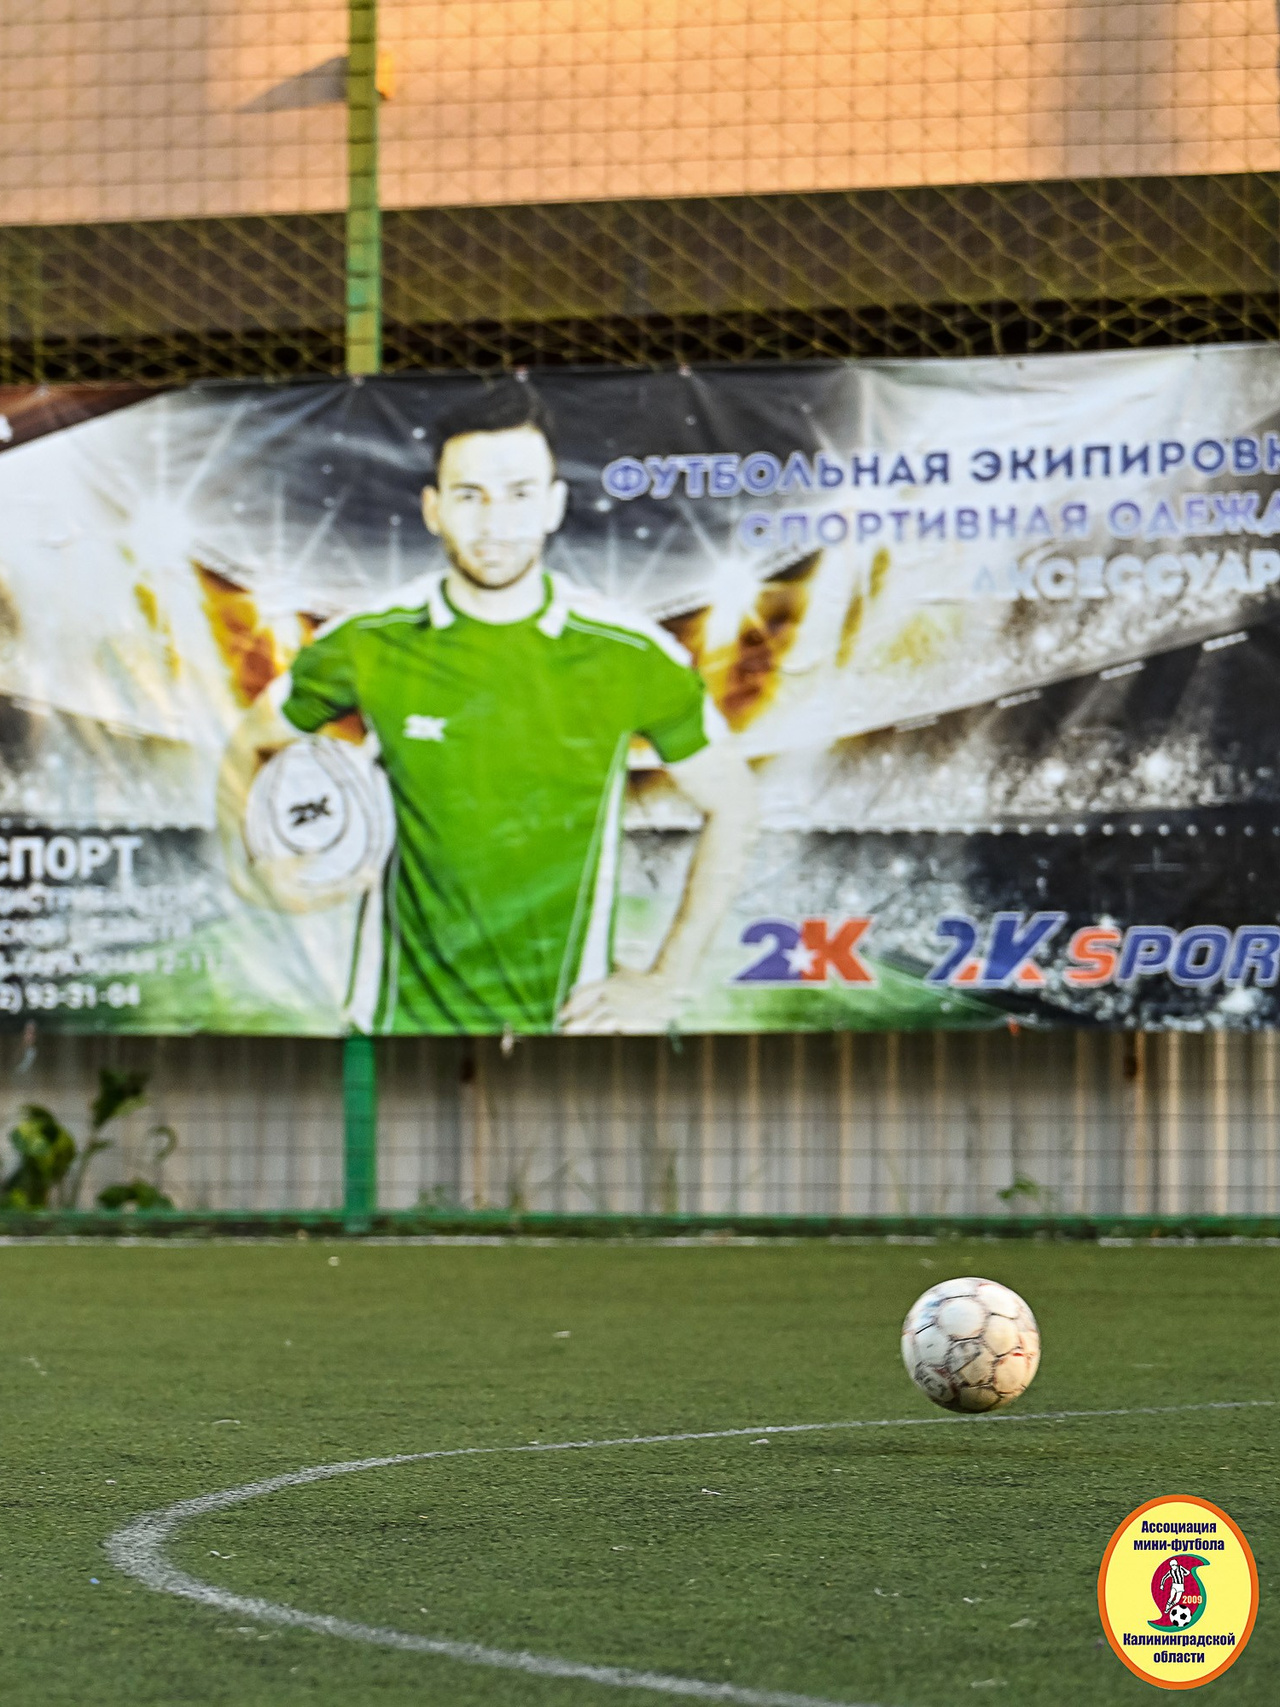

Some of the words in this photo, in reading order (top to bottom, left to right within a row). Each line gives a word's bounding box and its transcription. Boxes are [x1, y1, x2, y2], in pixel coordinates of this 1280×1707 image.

[602, 448, 950, 500] ФУТБОЛЬНАЯ
[738, 500, 1090, 546] СПОРТИВНАЯ
[23, 982, 141, 1009] 93-31-04
